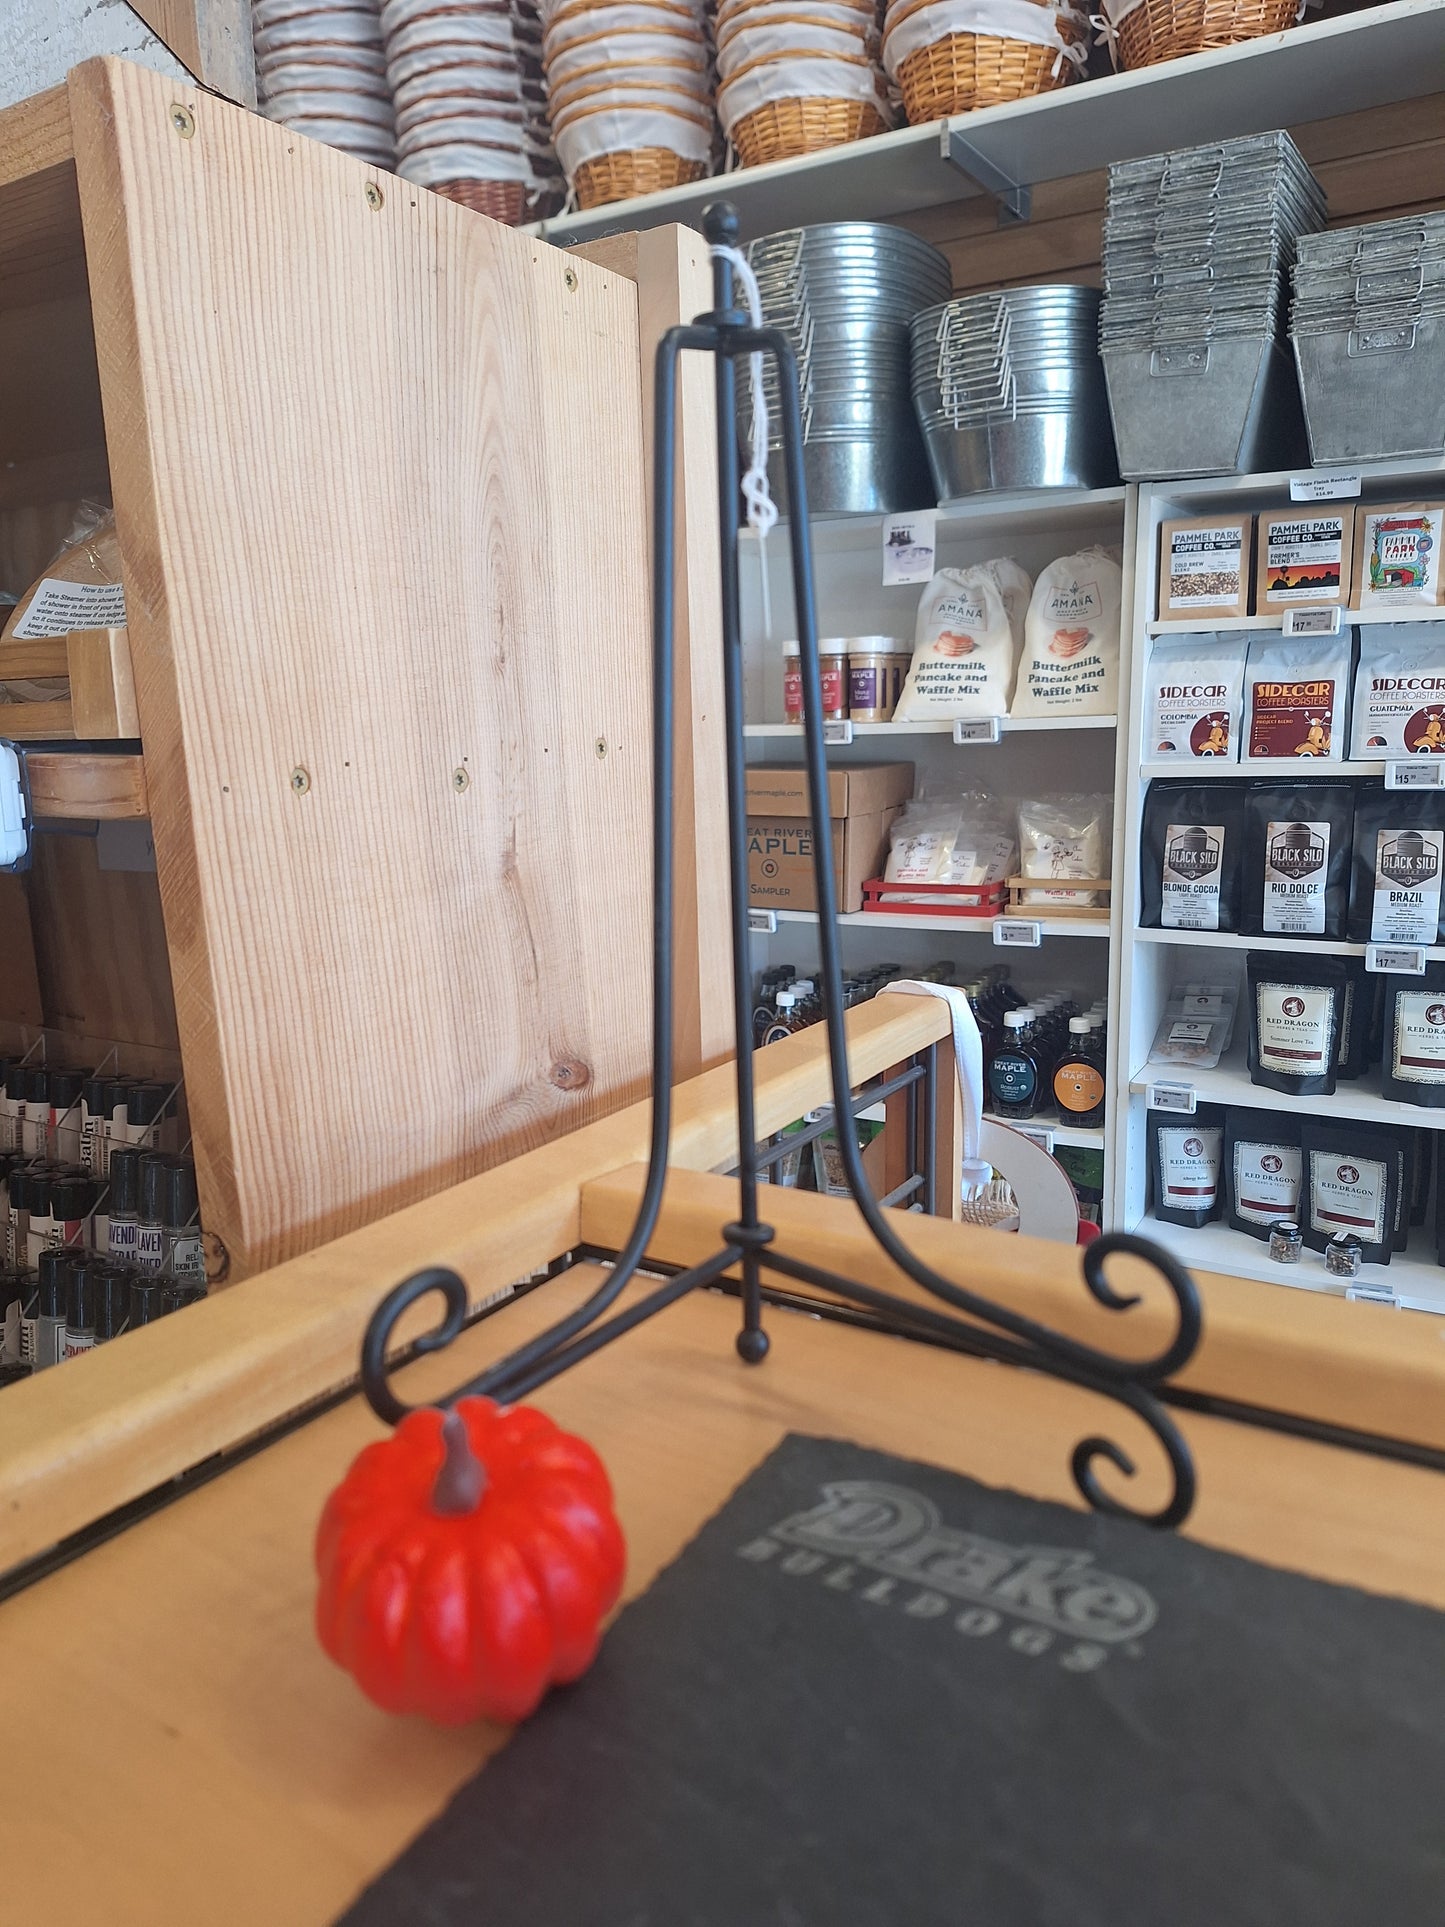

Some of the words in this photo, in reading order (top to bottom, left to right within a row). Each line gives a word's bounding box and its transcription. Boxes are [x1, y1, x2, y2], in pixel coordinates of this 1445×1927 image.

[1271, 524, 1310, 534] PAMMEL
[1313, 521, 1339, 531] PARK
[1174, 532, 1212, 543] PAMMEL
[1214, 530, 1240, 540] PARK
[1272, 535, 1300, 544] COFFEE
[1176, 544, 1202, 552] COFFEE
[1386, 544, 1415, 554] PARK
[45, 591, 59, 599] Take
[60, 594, 84, 602] Steamer
[1051, 595, 1093, 608] AMANA
[48, 601, 70, 609] shower
[54, 609, 68, 617] onto
[938, 604, 983, 618] AMANA
[27, 622, 42, 630] keep
[47, 617, 76, 625] continues
[919, 662, 986, 671] Buttermilk
[1032, 656, 1102, 672] Buttermilk
[914, 673, 962, 682] Pancake
[964, 674, 988, 682] and
[1028, 674, 1078, 684] Pancake
[1081, 668, 1105, 680] and
[917, 686, 955, 694] Waffle
[957, 685, 980, 694] Mix
[1257, 682, 1330, 698] SIDECAR
[1371, 678, 1445, 691] SIDECAR
[1032, 687, 1072, 698] Waffle
[1075, 683, 1099, 694] Mix
[1159, 685, 1227, 698] SIDECAR
[1370, 691, 1400, 701] COFFEE
[1158, 699, 1185, 708] COFFEE
[1187, 699, 1226, 707] ROASTERS
[1257, 698, 1285, 706] COFFEE
[1287, 697, 1329, 706] ROASTERS
[747, 828, 768, 836] EAT
[774, 828, 813, 838] RIVER
[748, 838, 813, 856] APLE
[1170, 851, 1197, 863] BLACK
[1200, 852, 1218, 864] SILO
[1272, 849, 1300, 861] BLACK
[1303, 849, 1323, 862] SILO
[1383, 856, 1413, 869] BLACK
[1416, 857, 1436, 870] SILO
[1164, 883, 1192, 893] BLONDE
[1194, 885, 1218, 894] COCOA
[1272, 883, 1286, 893] RIO
[1290, 884, 1319, 894] DOLCE
[1390, 892, 1424, 903] BRAZIL
[994, 1064, 1026, 1073] MAPLE
[1061, 1072, 1097, 1081] MAPLE
[81, 1121, 94, 1169] Balm
[1262, 1175, 1296, 1184] DRAGON
[1340, 1185, 1373, 1196] DRAGON
[175, 1263, 190, 1271] SKIN
[770, 1479, 1158, 1643] Drake
